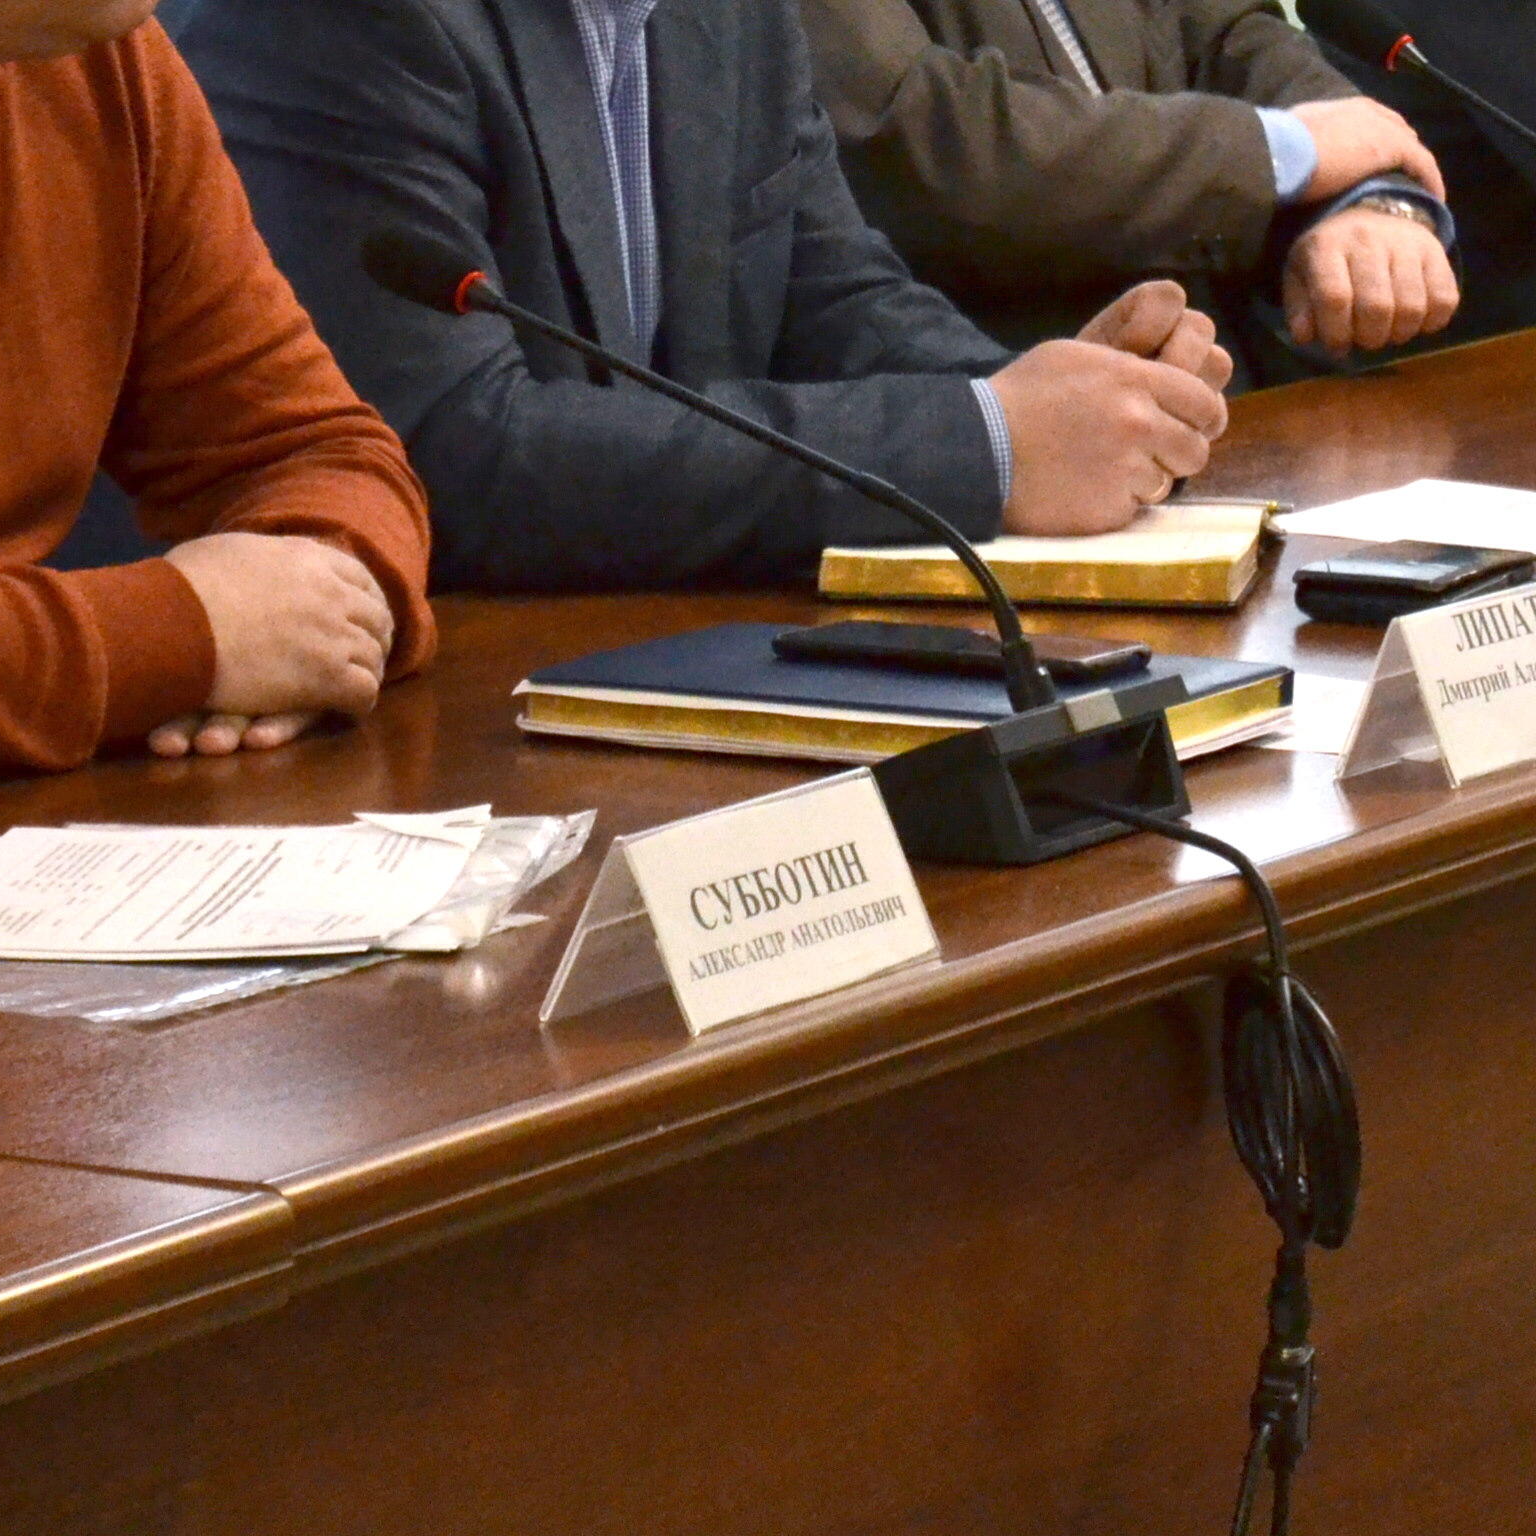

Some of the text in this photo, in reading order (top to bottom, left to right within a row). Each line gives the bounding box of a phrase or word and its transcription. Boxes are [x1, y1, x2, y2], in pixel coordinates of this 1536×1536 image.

[1437, 665, 1513, 708] Дмитрий
[689, 841, 871, 931] СУББОТИН
[688, 895, 907, 982] АЛЕКСАНДР АНАТОЛЬЕВИЧ
